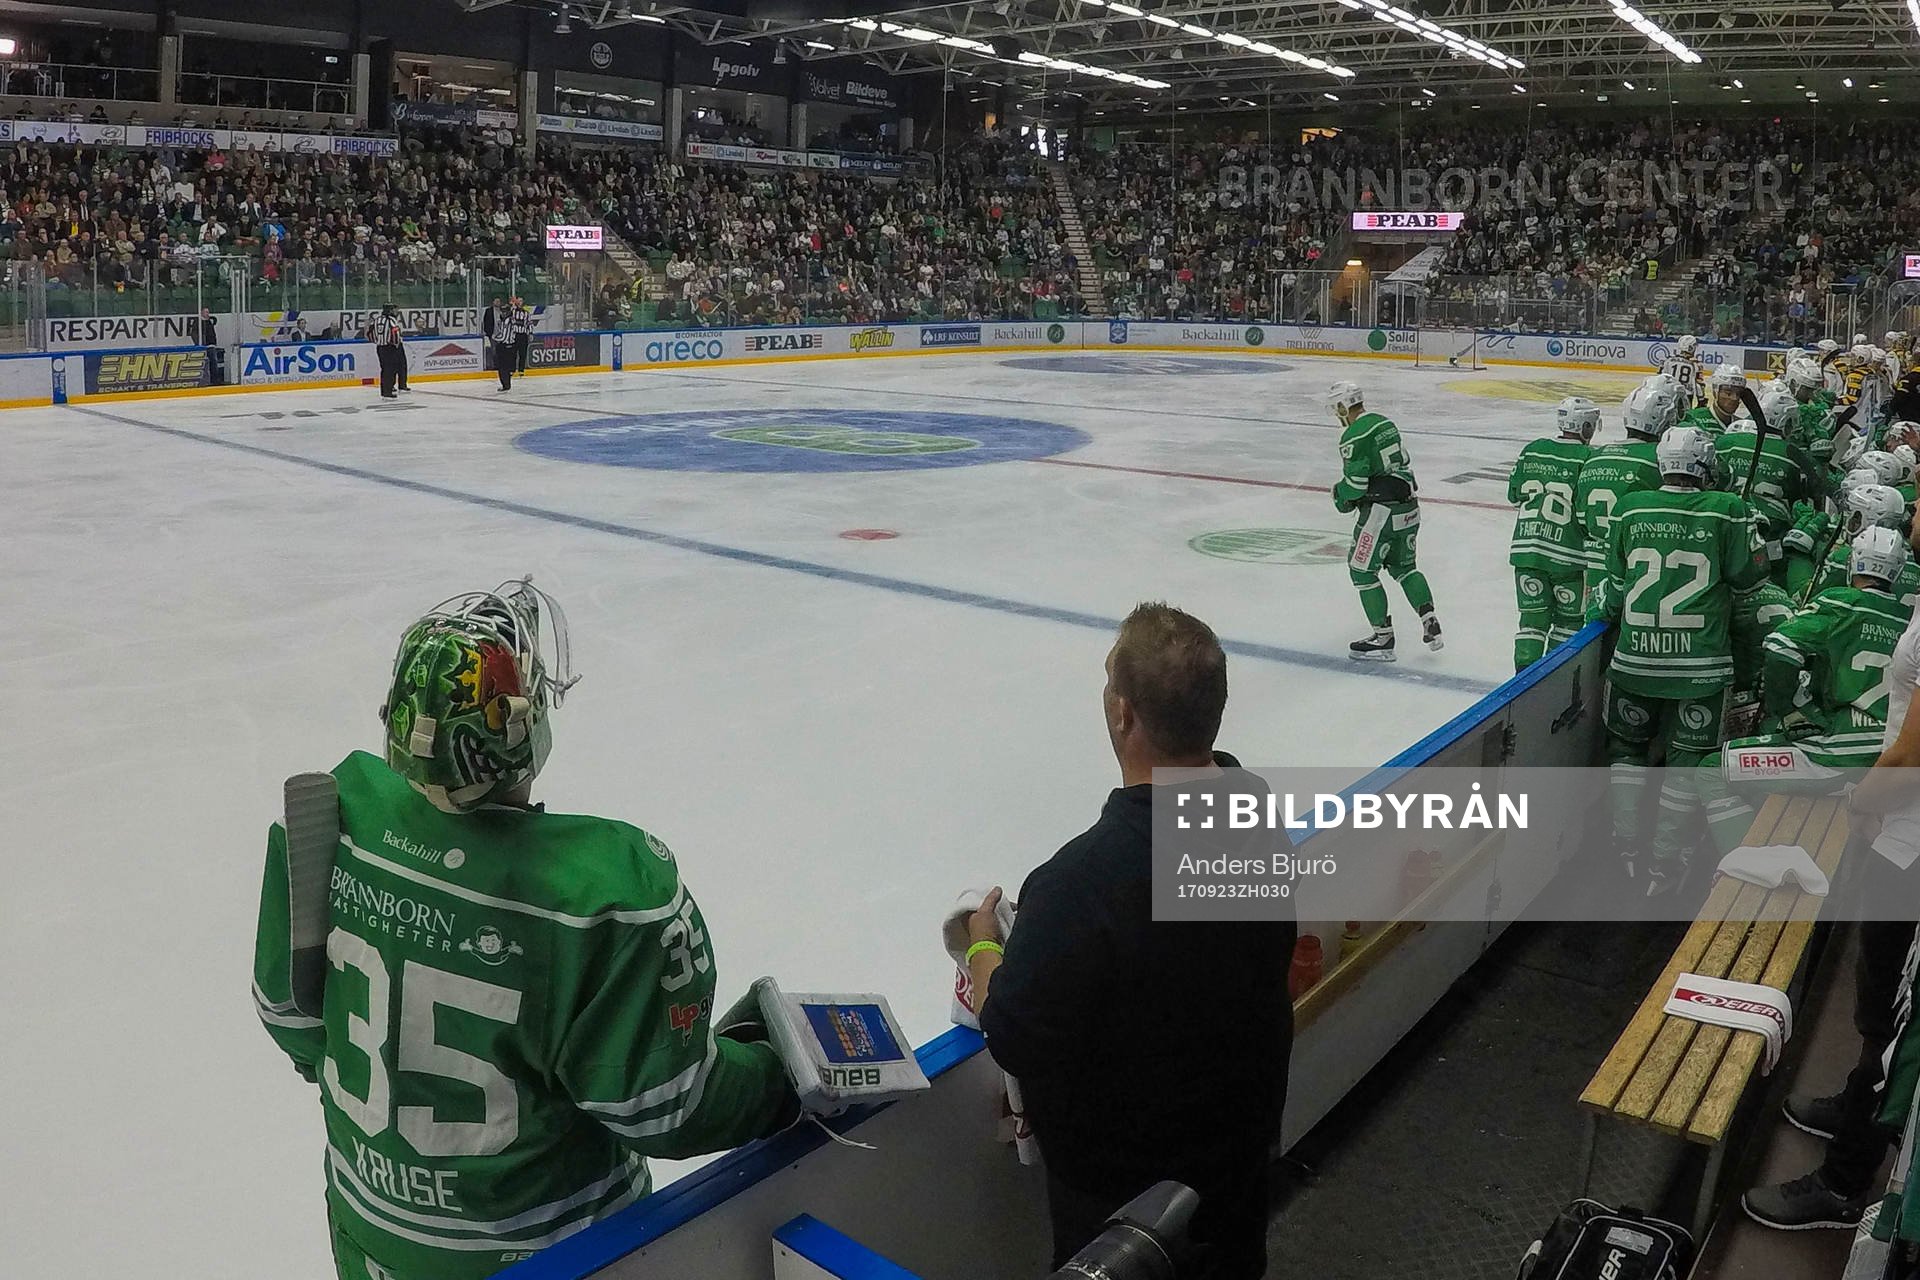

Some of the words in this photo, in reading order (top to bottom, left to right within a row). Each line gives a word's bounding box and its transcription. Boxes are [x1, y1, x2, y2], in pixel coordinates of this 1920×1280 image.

[146, 128, 214, 146] FRIBROCKS
[334, 138, 396, 155] FRIBROCKS
[1568, 158, 1784, 212] CENTER
[1376, 214, 1439, 227] PEAB
[556, 229, 594, 239] PEAB
[340, 308, 478, 331] RESARTNER
[754, 334, 814, 350] PEAB
[851, 331, 894, 351] WALLIN
[994, 328, 1042, 340] Backahill
[1182, 328, 1240, 341] Backahill
[1388, 331, 1415, 343] Solid
[532, 348, 576, 362] SYSTEM
[646, 339, 723, 361] areco
[1565, 340, 1625, 358] Brinova
[244, 345, 356, 376] AirSon
[1671, 363, 1691, 384] 18
[147, 381, 200, 389] TRANSPORT
[1670, 461, 1680, 469] 22
[1519, 520, 1563, 542] FAIRCHILD
[1625, 547, 1711, 628] 22
[1631, 630, 1691, 653] SANDIN
[1742, 755, 1790, 768] ER-HO
[382, 829, 441, 864] Backahill
[660, 906, 710, 992] 35
[322, 925, 523, 1157] 35
[351, 1135, 463, 1213] KRUSE
